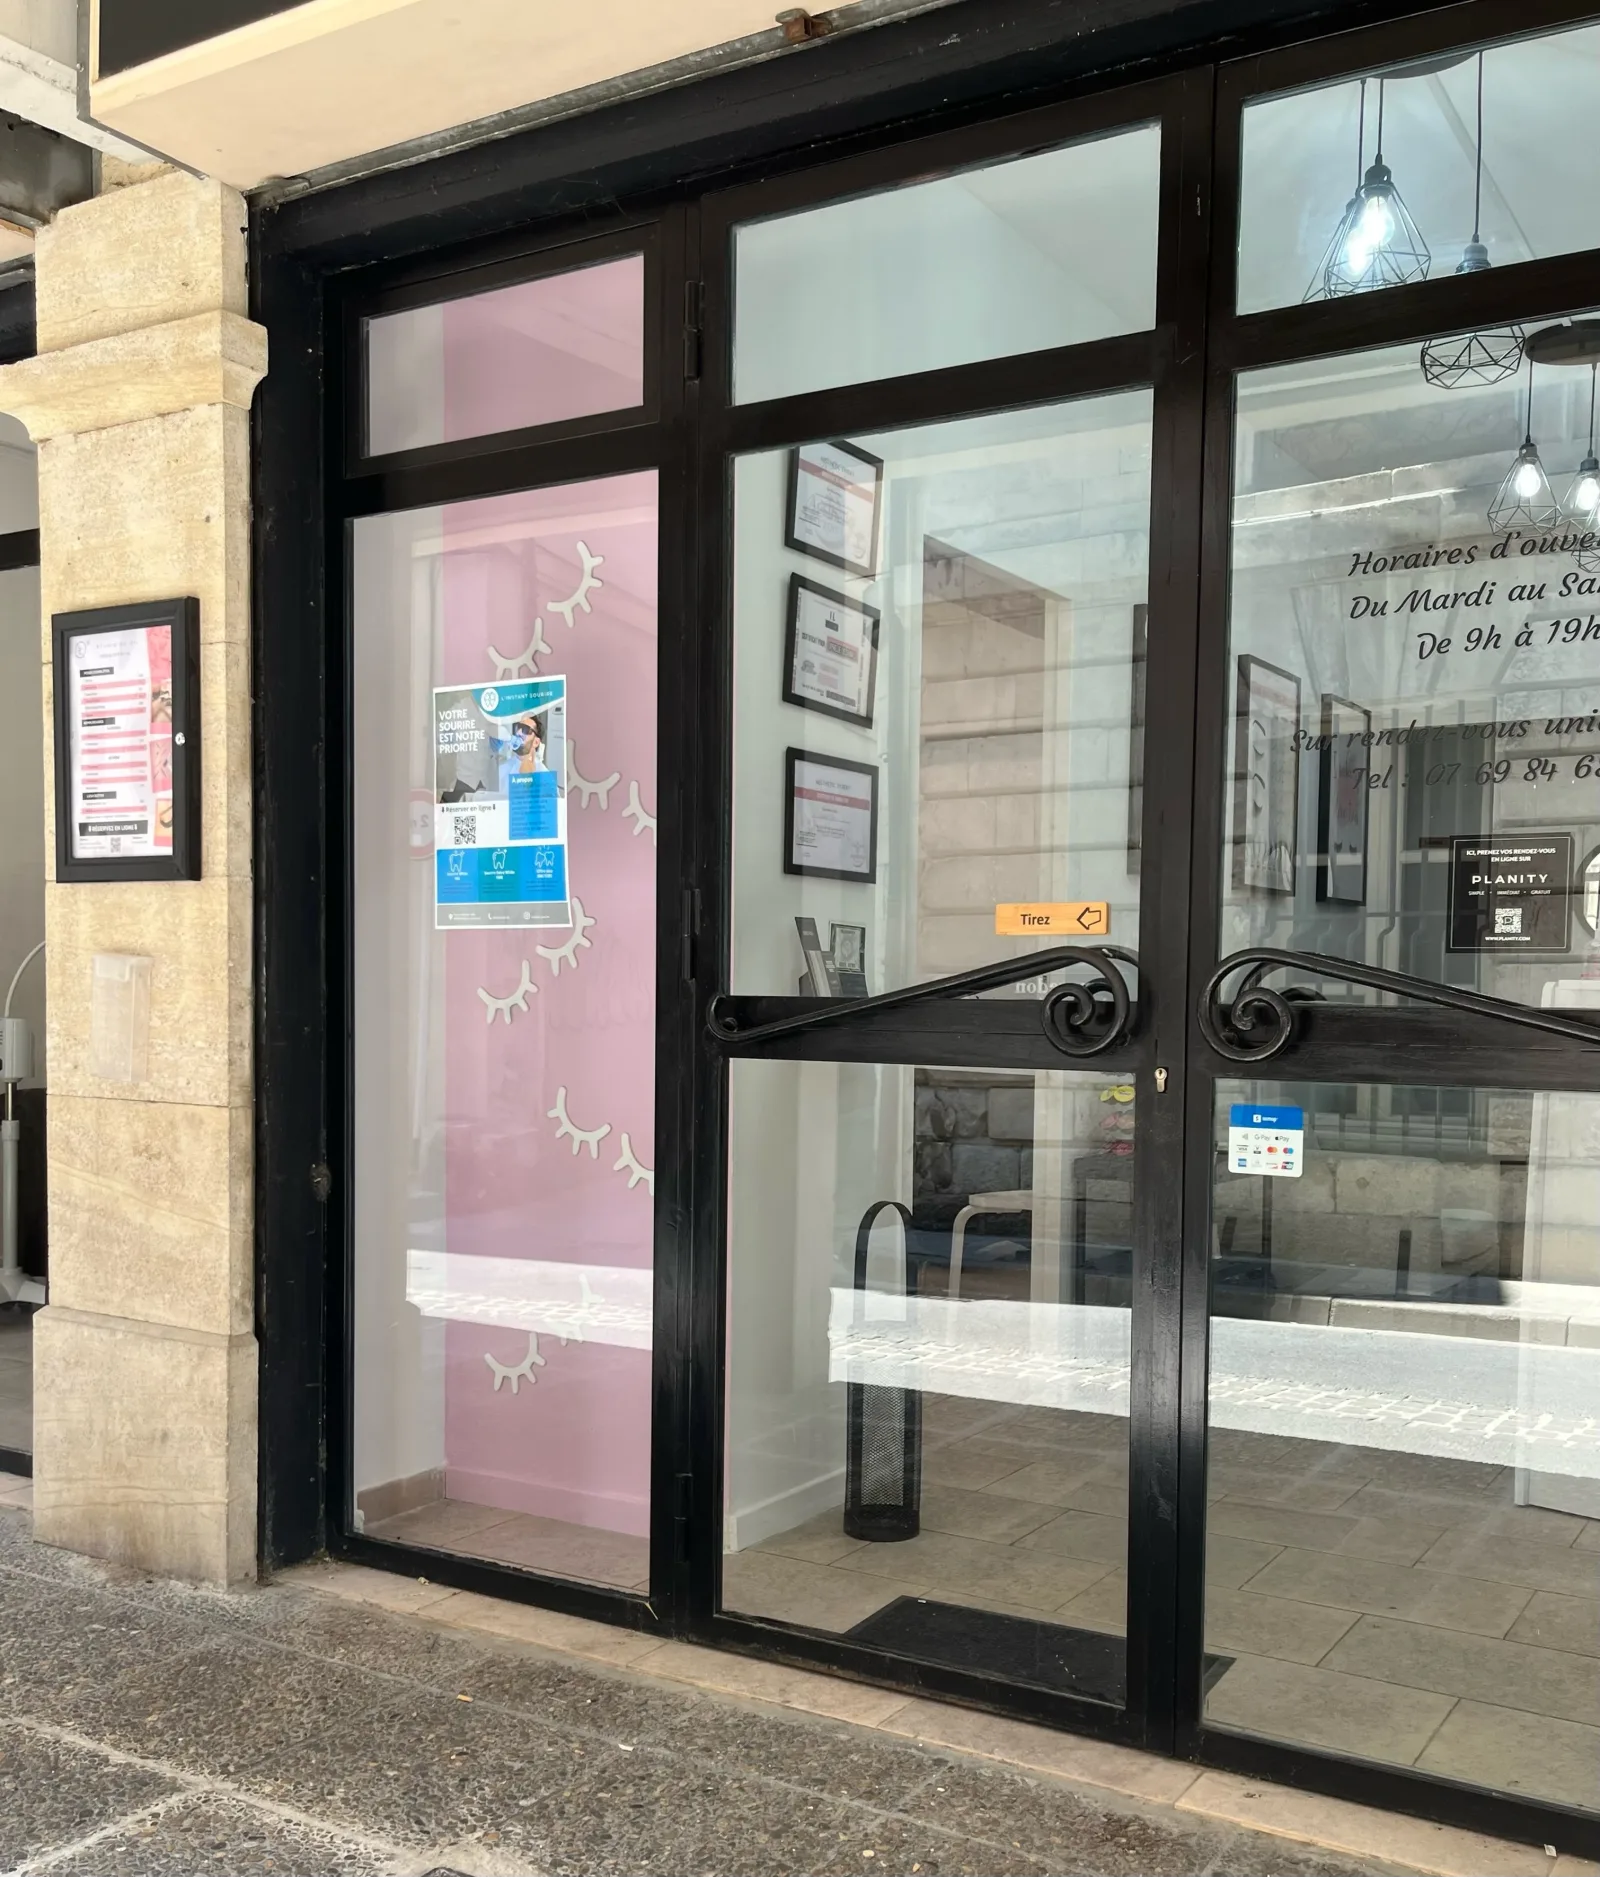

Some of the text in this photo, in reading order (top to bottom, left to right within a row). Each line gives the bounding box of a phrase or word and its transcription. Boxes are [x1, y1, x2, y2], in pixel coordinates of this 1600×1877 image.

[1348, 531, 1600, 577] Horaires d'ouve
[1350, 572, 1600, 619] Du Mardi au Sa
[1417, 614, 1600, 660] De 9h à 19h
[438, 709, 468, 720] VOTRE
[438, 719, 476, 732] SOURIRE
[1290, 708, 1600, 752] Sur rendez-vous uni
[439, 730, 486, 743] EST NOTRE
[439, 740, 479, 754] PRIORITÉ
[1352, 764, 1394, 790] Tel
[1426, 763, 1461, 786] 07
[1475, 759, 1511, 786] 69
[1523, 757, 1558, 782] 84
[1513, 847, 1556, 855] RENDEZ-VOUS
[1471, 873, 1548, 884] PLANITY
[1020, 913, 1050, 926] Tirez
